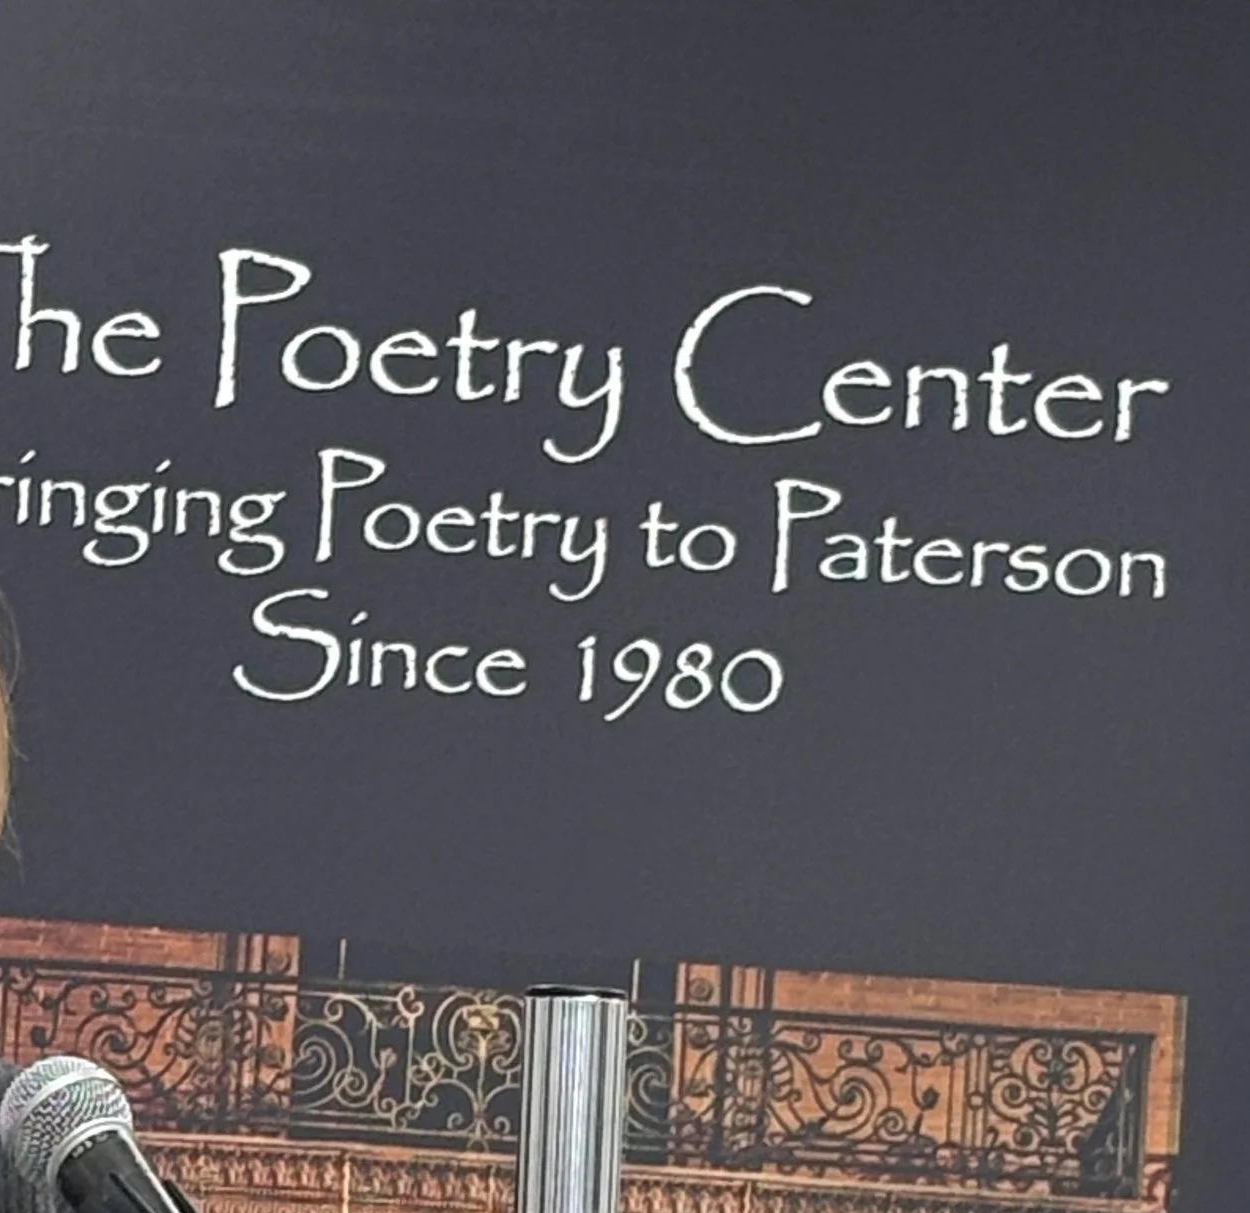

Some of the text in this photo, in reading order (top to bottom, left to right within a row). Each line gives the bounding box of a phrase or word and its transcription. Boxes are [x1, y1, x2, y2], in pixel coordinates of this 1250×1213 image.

[214, 247, 624, 464] Poetry
[674, 285, 1170, 443] Center
[315, 447, 608, 603] Poetry
[638, 501, 738, 571] to
[772, 478, 1167, 600] Paterson
[232, 588, 785, 722] Since 1980
